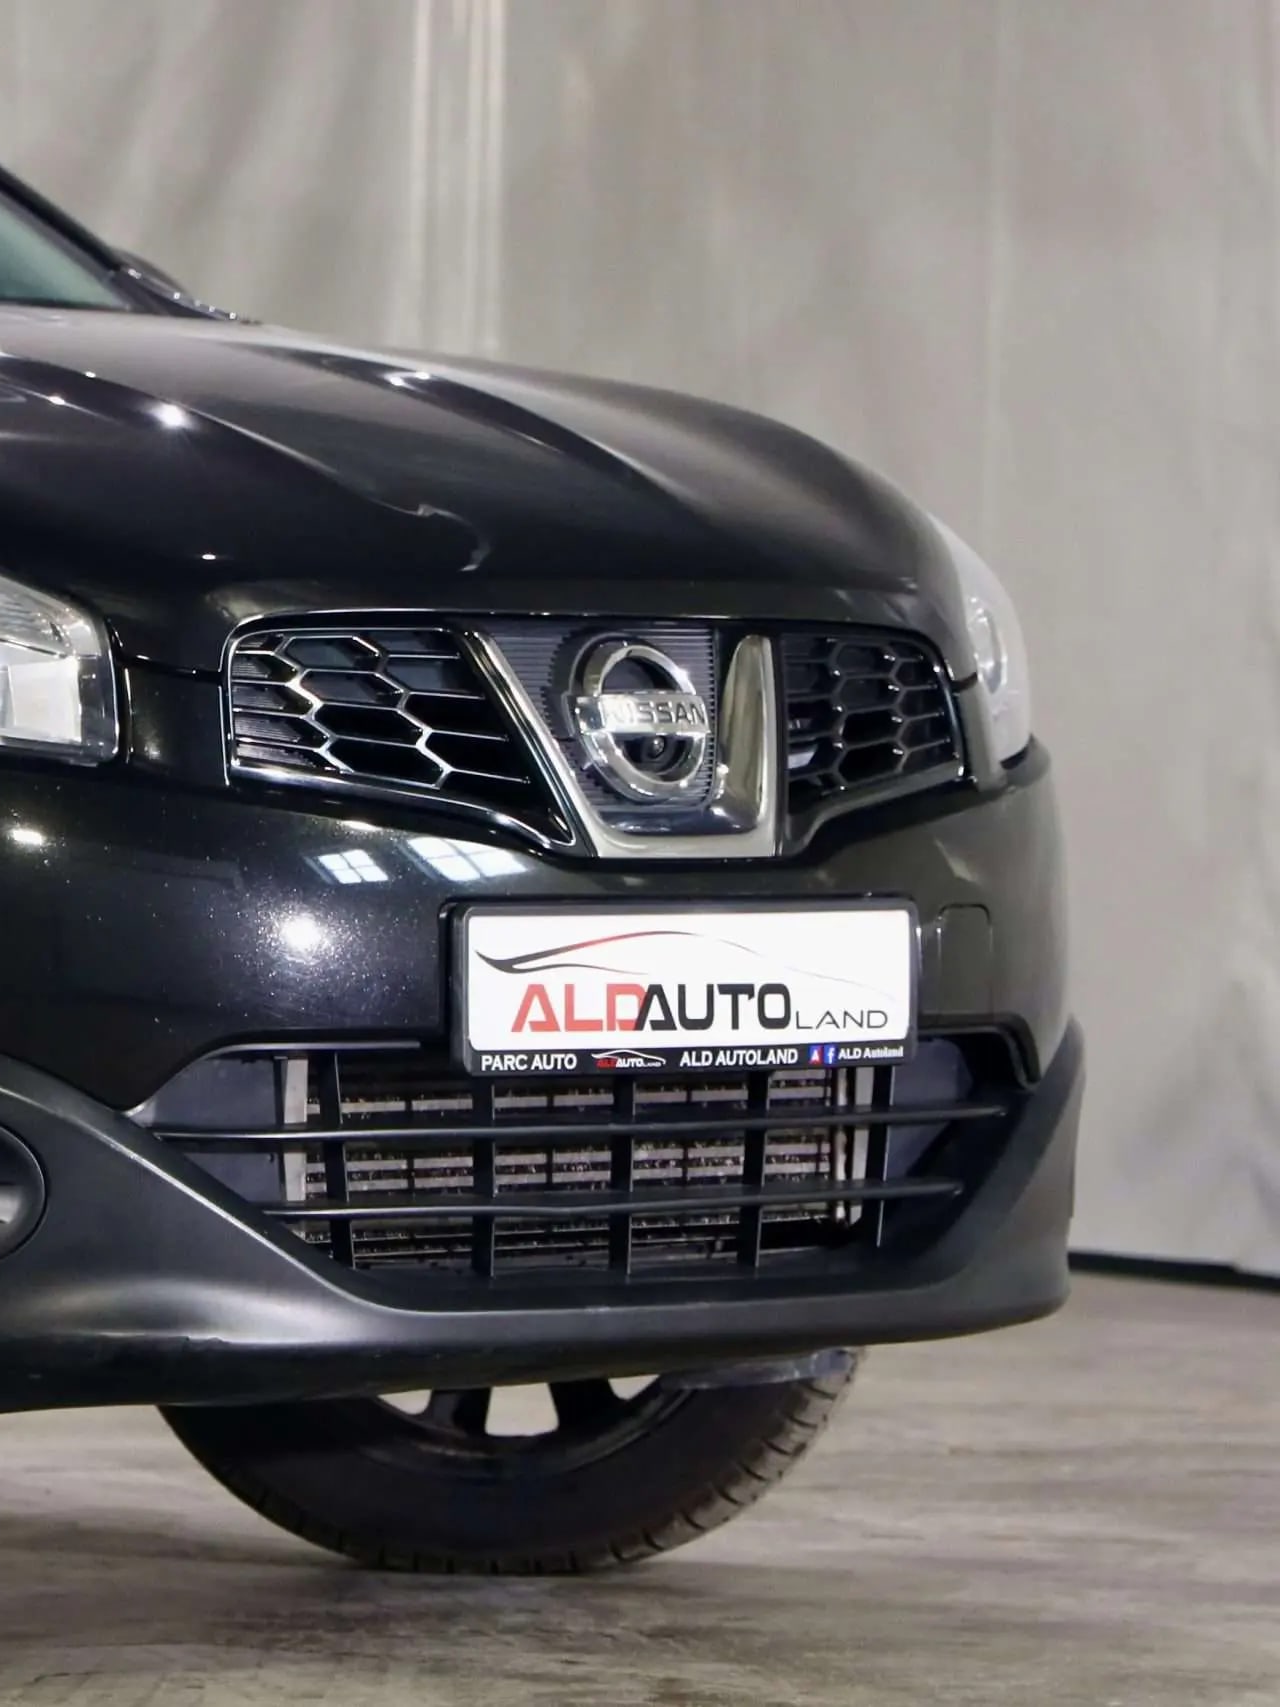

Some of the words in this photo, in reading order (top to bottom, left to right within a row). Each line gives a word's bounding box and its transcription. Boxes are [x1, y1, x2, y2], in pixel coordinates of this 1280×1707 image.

[606, 700, 707, 726] NISSAN
[680, 1051, 712, 1067] ALD
[715, 1048, 798, 1066] AUTOLAND
[838, 1047, 861, 1059] ALD
[481, 1054, 528, 1071] PARC
[531, 1054, 577, 1070] AUTO
